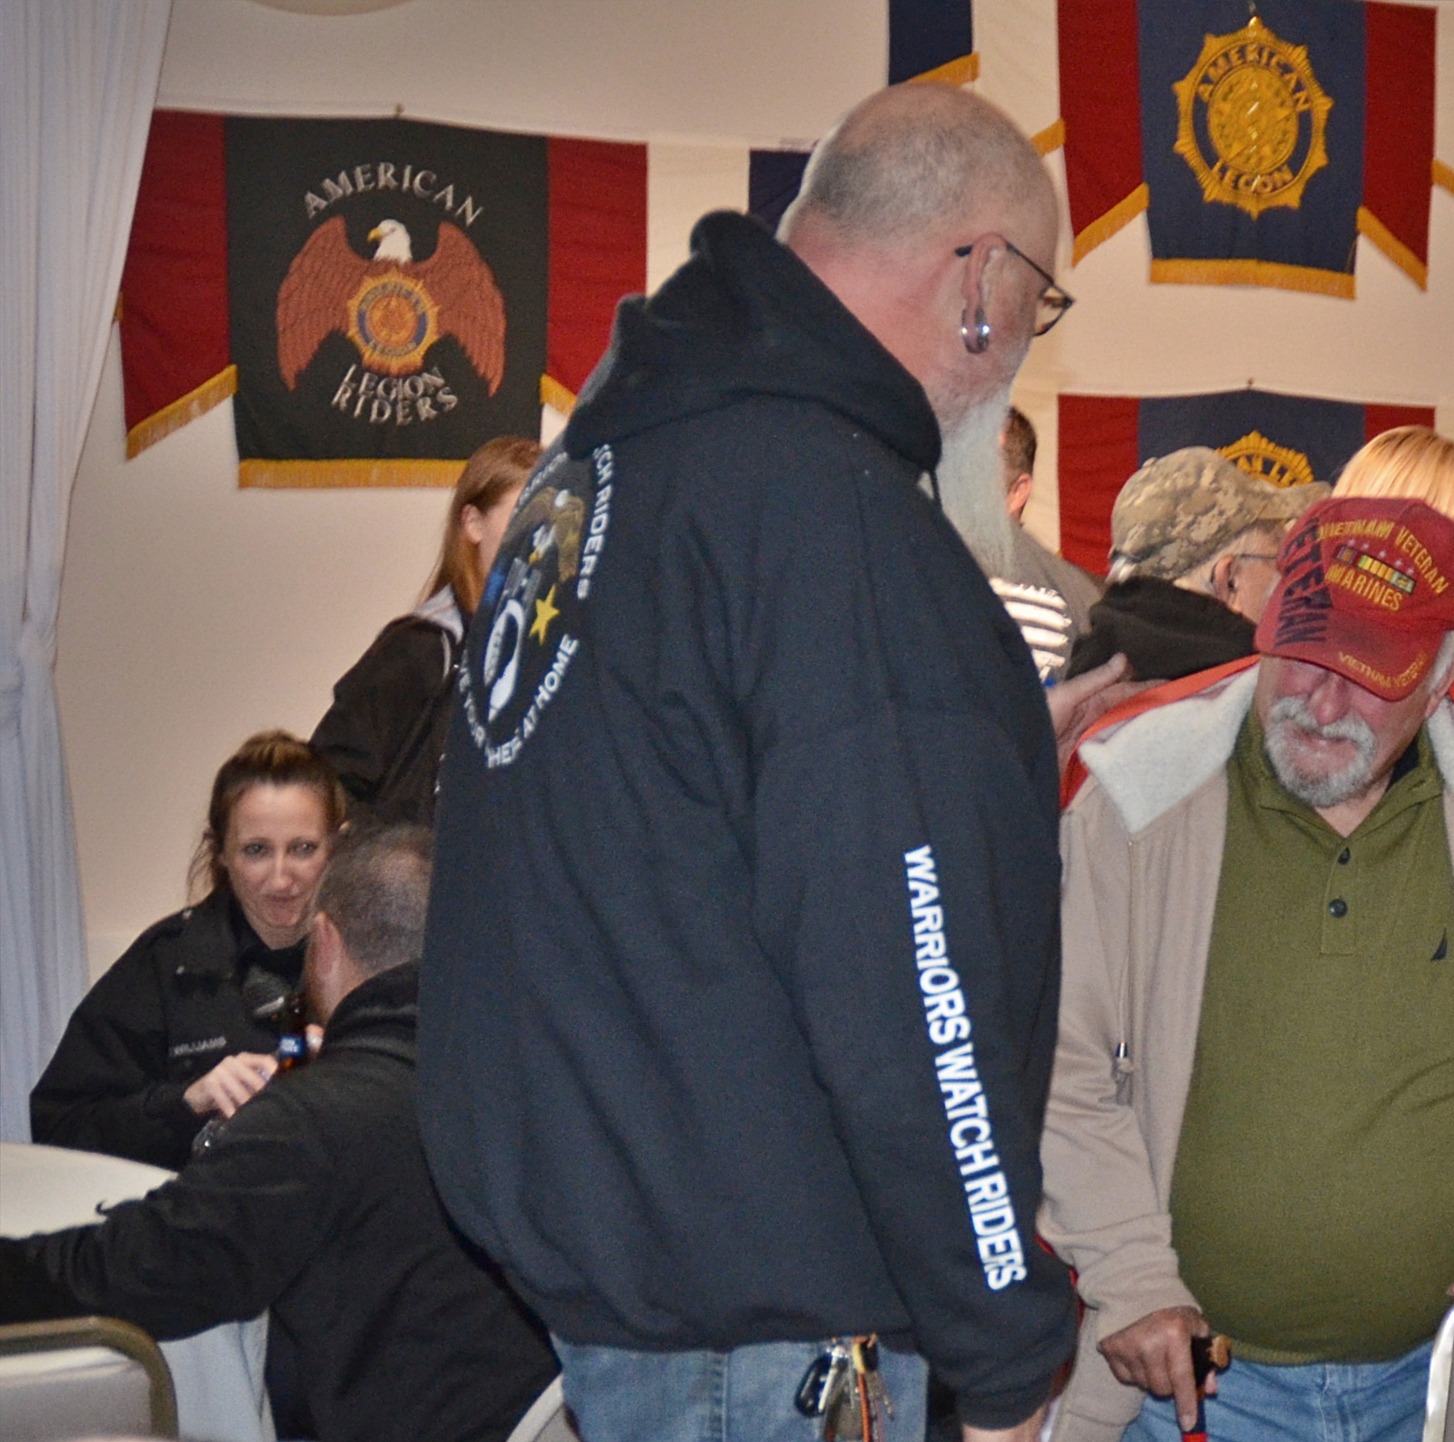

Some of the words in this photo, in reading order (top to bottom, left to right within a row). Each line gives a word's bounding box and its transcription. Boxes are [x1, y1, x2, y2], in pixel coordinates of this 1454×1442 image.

[1199, 45, 1311, 113] AMERICAN
[303, 162, 484, 227] AMERICAN
[331, 385, 458, 426] RIDERS
[338, 363, 445, 401] LEGION
[577, 484, 612, 599] RIDERS
[1317, 518, 1396, 541] VIETNAM
[1395, 526, 1449, 595] VETERAN
[1324, 563, 1404, 612] MARINES
[534, 633, 579, 710] HOME
[1338, 650, 1393, 689] VIETNAM
[904, 844, 971, 1046] WARRIORS
[934, 1042, 1000, 1177] WATCH
[964, 1171, 1028, 1291] RIDERS
